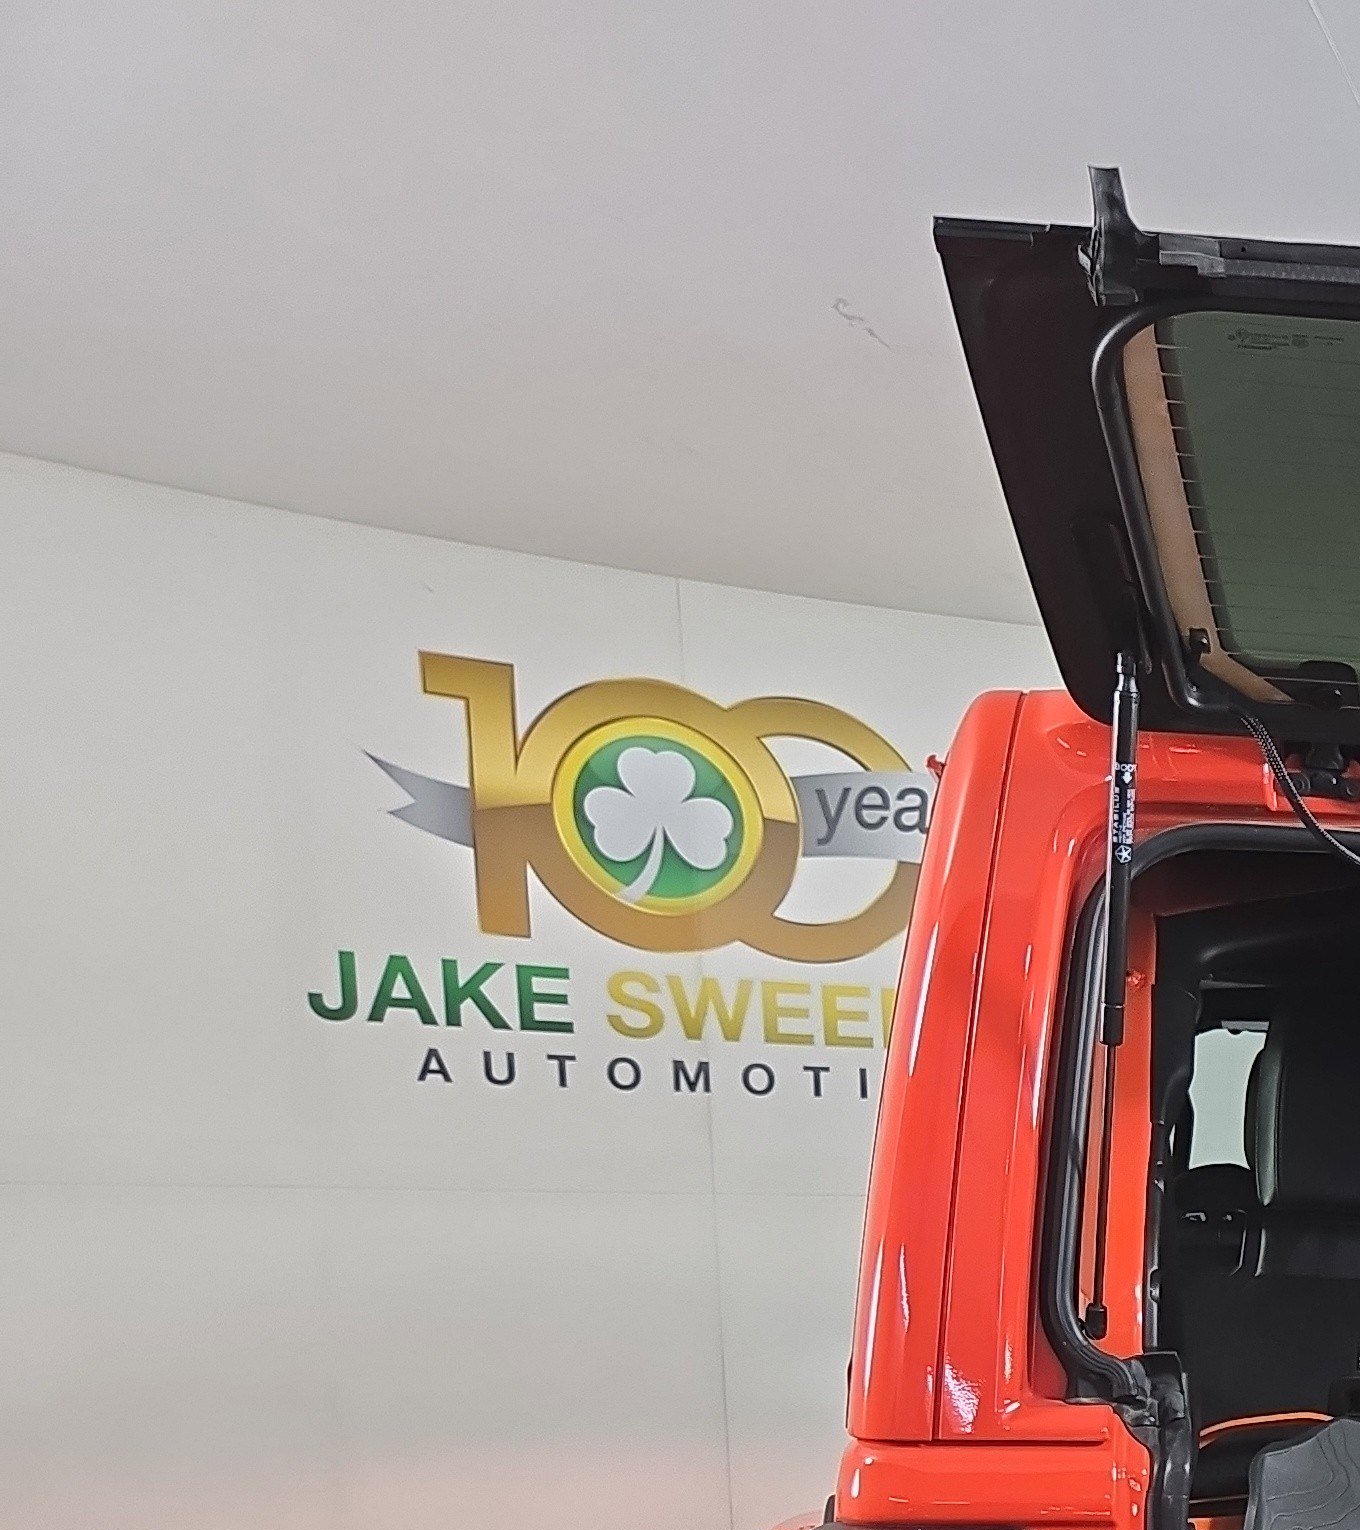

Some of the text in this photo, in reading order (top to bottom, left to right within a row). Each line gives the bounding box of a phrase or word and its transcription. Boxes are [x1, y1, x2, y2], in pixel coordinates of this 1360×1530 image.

[815, 785, 929, 847] yea
[307, 949, 896, 1049] JAKE SWEE
[417, 1047, 869, 1099] AUTOMOTI
